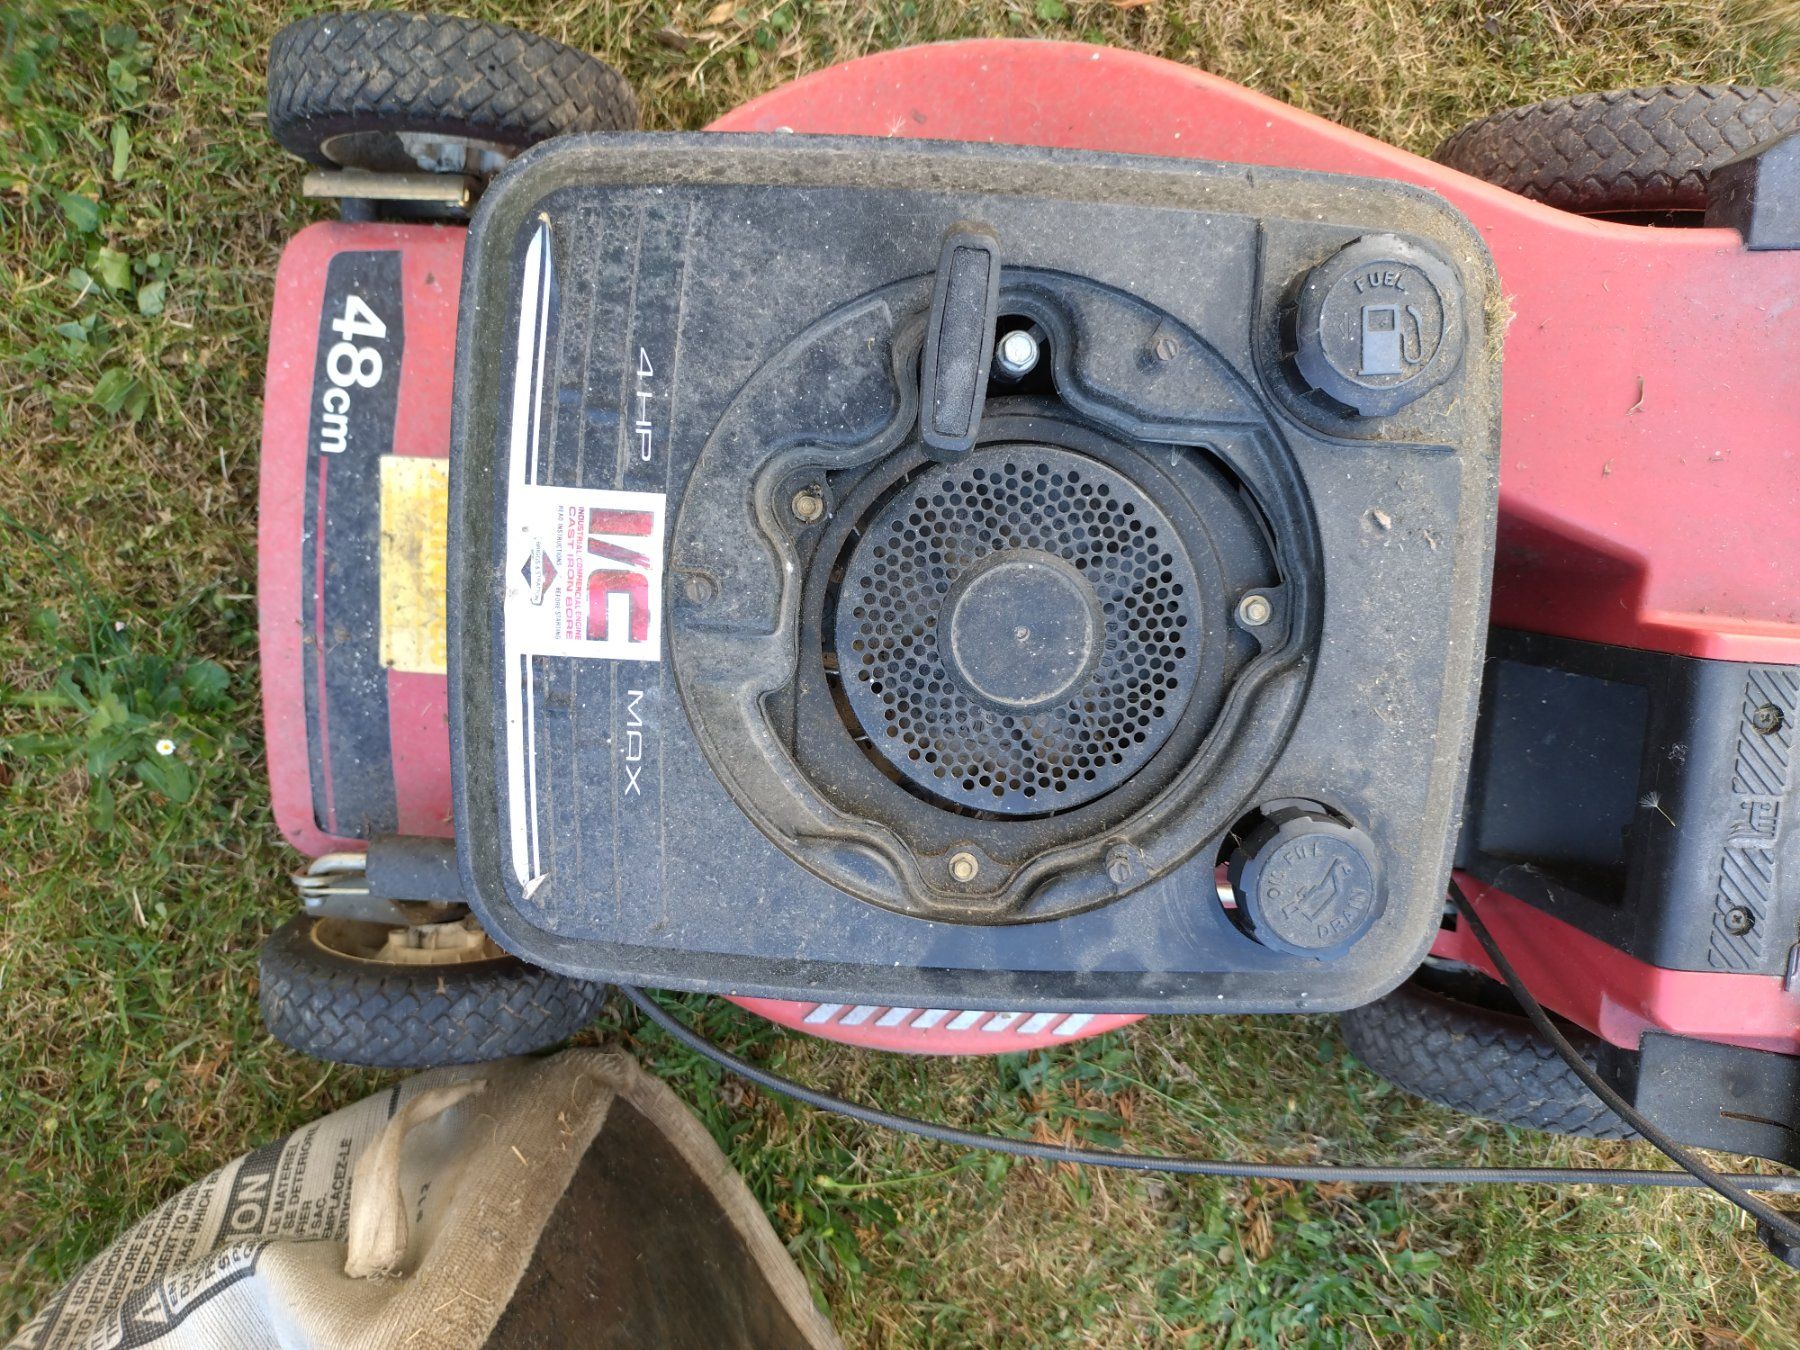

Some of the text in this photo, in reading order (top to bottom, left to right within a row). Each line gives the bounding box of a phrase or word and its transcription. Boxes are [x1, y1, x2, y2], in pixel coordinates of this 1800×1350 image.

[1354, 271, 1407, 294] FUEL
[320, 294, 387, 454] 48cm
[634, 347, 654, 462] 4 HP
[556, 523, 564, 566] INSTRUCTIONS
[565, 505, 576, 640] CAST IRON BORE
[554, 611, 562, 640] STARTING
[574, 611, 582, 640] ENGINE
[624, 690, 645, 796] MAX
[1266, 841, 1322, 900] OIL FILL
[1316, 886, 1368, 939] DRAIN
[273, 1140, 300, 1211] MATERIEL
[321, 1137, 353, 1239] EMPLACEZ-LE
[171, 1212, 190, 1233] TO
[187, 1187, 213, 1234] WHICH
[281, 1209, 298, 1230] SE
